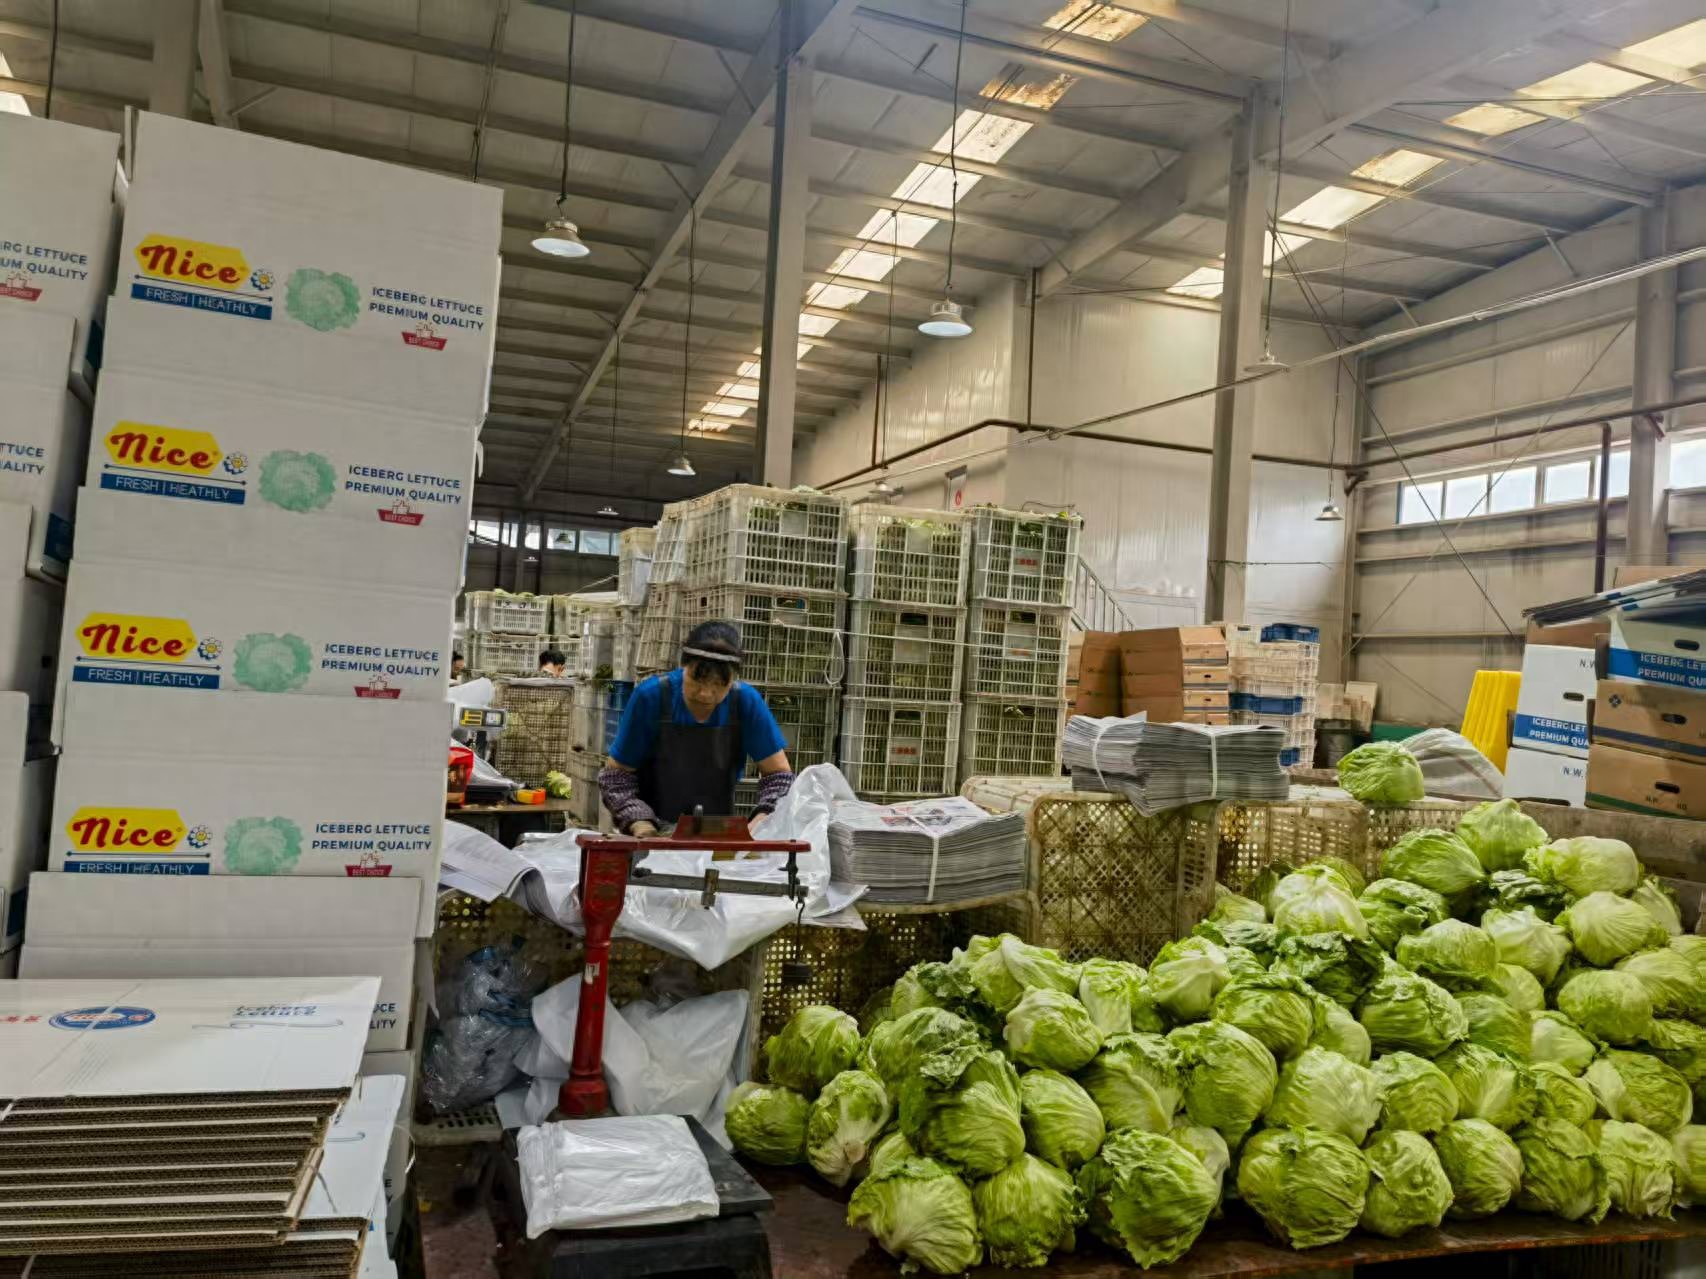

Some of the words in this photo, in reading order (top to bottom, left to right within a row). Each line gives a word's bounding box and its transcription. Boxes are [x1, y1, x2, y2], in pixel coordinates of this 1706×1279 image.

[26, 245, 88, 265] LETTUCE
[141, 245, 241, 284] Nice
[27, 262, 88, 281] QUALITY
[146, 287, 188, 304] FRESH
[200, 295, 258, 315] HEATHLY
[372, 286, 427, 305] ICEBERG
[430, 297, 484, 316] LETTUCE
[369, 302, 428, 321] PREMIUM
[432, 314, 484, 331] QUALITY
[110, 432, 214, 470] Nice
[349, 465, 404, 482] ICEBERG
[407, 473, 460, 489] LETTUCE
[115, 476, 160, 491] FRESH
[170, 484, 230, 500] HEATHLY
[345, 480, 405, 498] PREMIUM
[409, 489, 462, 505] QUALITY
[82, 623, 187, 656] Nice
[325, 643, 382, 657] ICEBERG
[385, 647, 439, 661] LETTUCE
[1640, 653, 1685, 669] ICEBERG
[88, 668, 132, 682] FRESH
[142, 673, 205, 687] HEATHLY
[321, 659, 382, 673] PREMIUM
[386, 664, 440, 677] QUALITY
[1637, 667, 1686, 683] PREMIUM
[1532, 717, 1568, 731] ICEBERG
[1529, 729, 1569, 744] PREMIUM
[72, 817, 177, 848] Nice
[316, 823, 372, 834] ICEBERG
[376, 824, 431, 834] LETTUCE
[312, 840, 374, 850] PREMIUM
[378, 840, 432, 852] QUALITY
[79, 862, 122, 873] FRESH
[133, 863, 195, 875] HEATHLY
